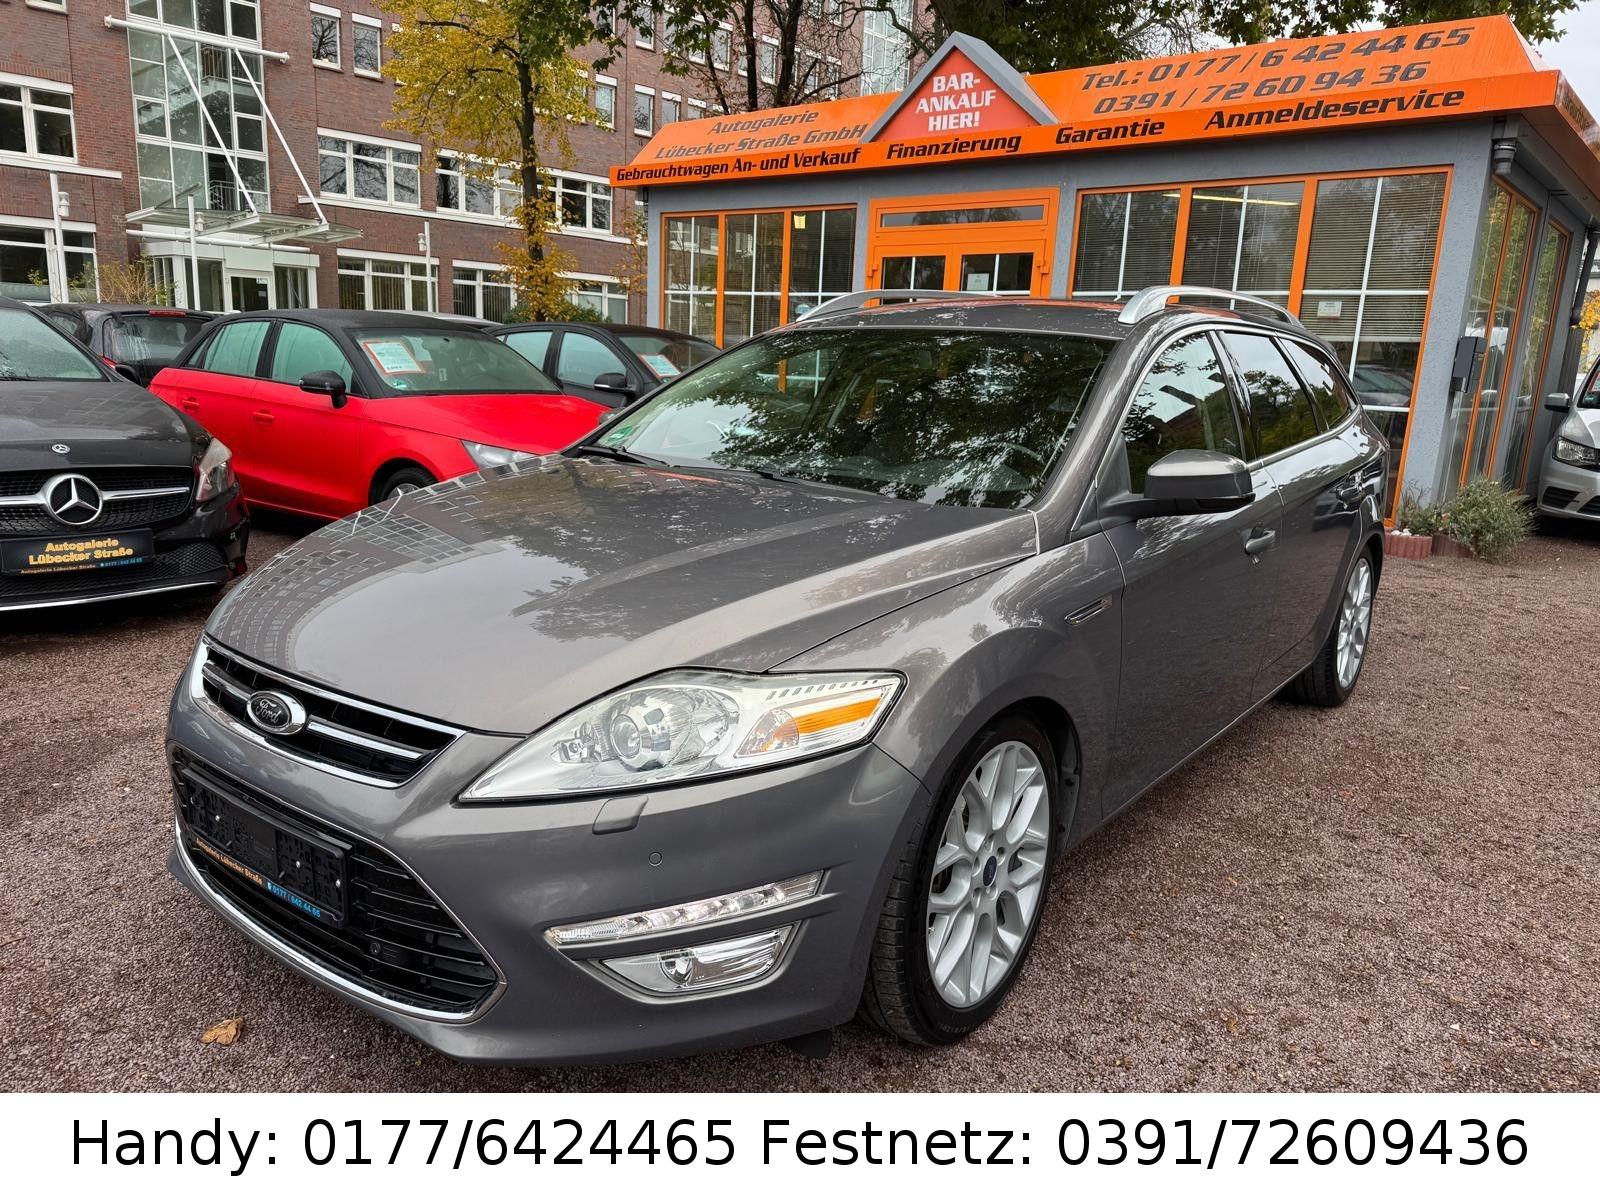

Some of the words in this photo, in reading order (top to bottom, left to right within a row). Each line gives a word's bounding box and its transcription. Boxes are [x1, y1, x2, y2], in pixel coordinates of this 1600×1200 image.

[1081, 69, 1144, 91] Tel.:
[1291, 42, 1346, 63] 42
[1351, 34, 1408, 56] 44
[1414, 26, 1476, 50] 65
[932, 71, 981, 93] BAR-
[1253, 75, 1307, 97] 60
[1310, 67, 1366, 91] 94
[1371, 60, 1431, 85] 36
[915, 89, 997, 114] ANKAUF
[1203, 88, 1465, 131] Anmeldeservice
[706, 110, 819, 135] Autogalerie
[928, 111, 980, 131] HIER!
[1055, 118, 1165, 145] Garantie
[654, 141, 735, 159] Lübecker
[735, 133, 801, 151] Straße
[803, 123, 869, 144] GmbH
[886, 135, 1022, 160] Finanzierung
[616, 162, 729, 181] Gebrauchtwagen
[731, 158, 757, 173] An-
[760, 153, 790, 171] und
[794, 147, 862, 168] Verkauf
[28, 550, 91, 566] Lübecker
[93, 547, 134, 559] Straße
[45, 537, 119, 552] Autogalerie
[255, 698, 282, 724] Ford
